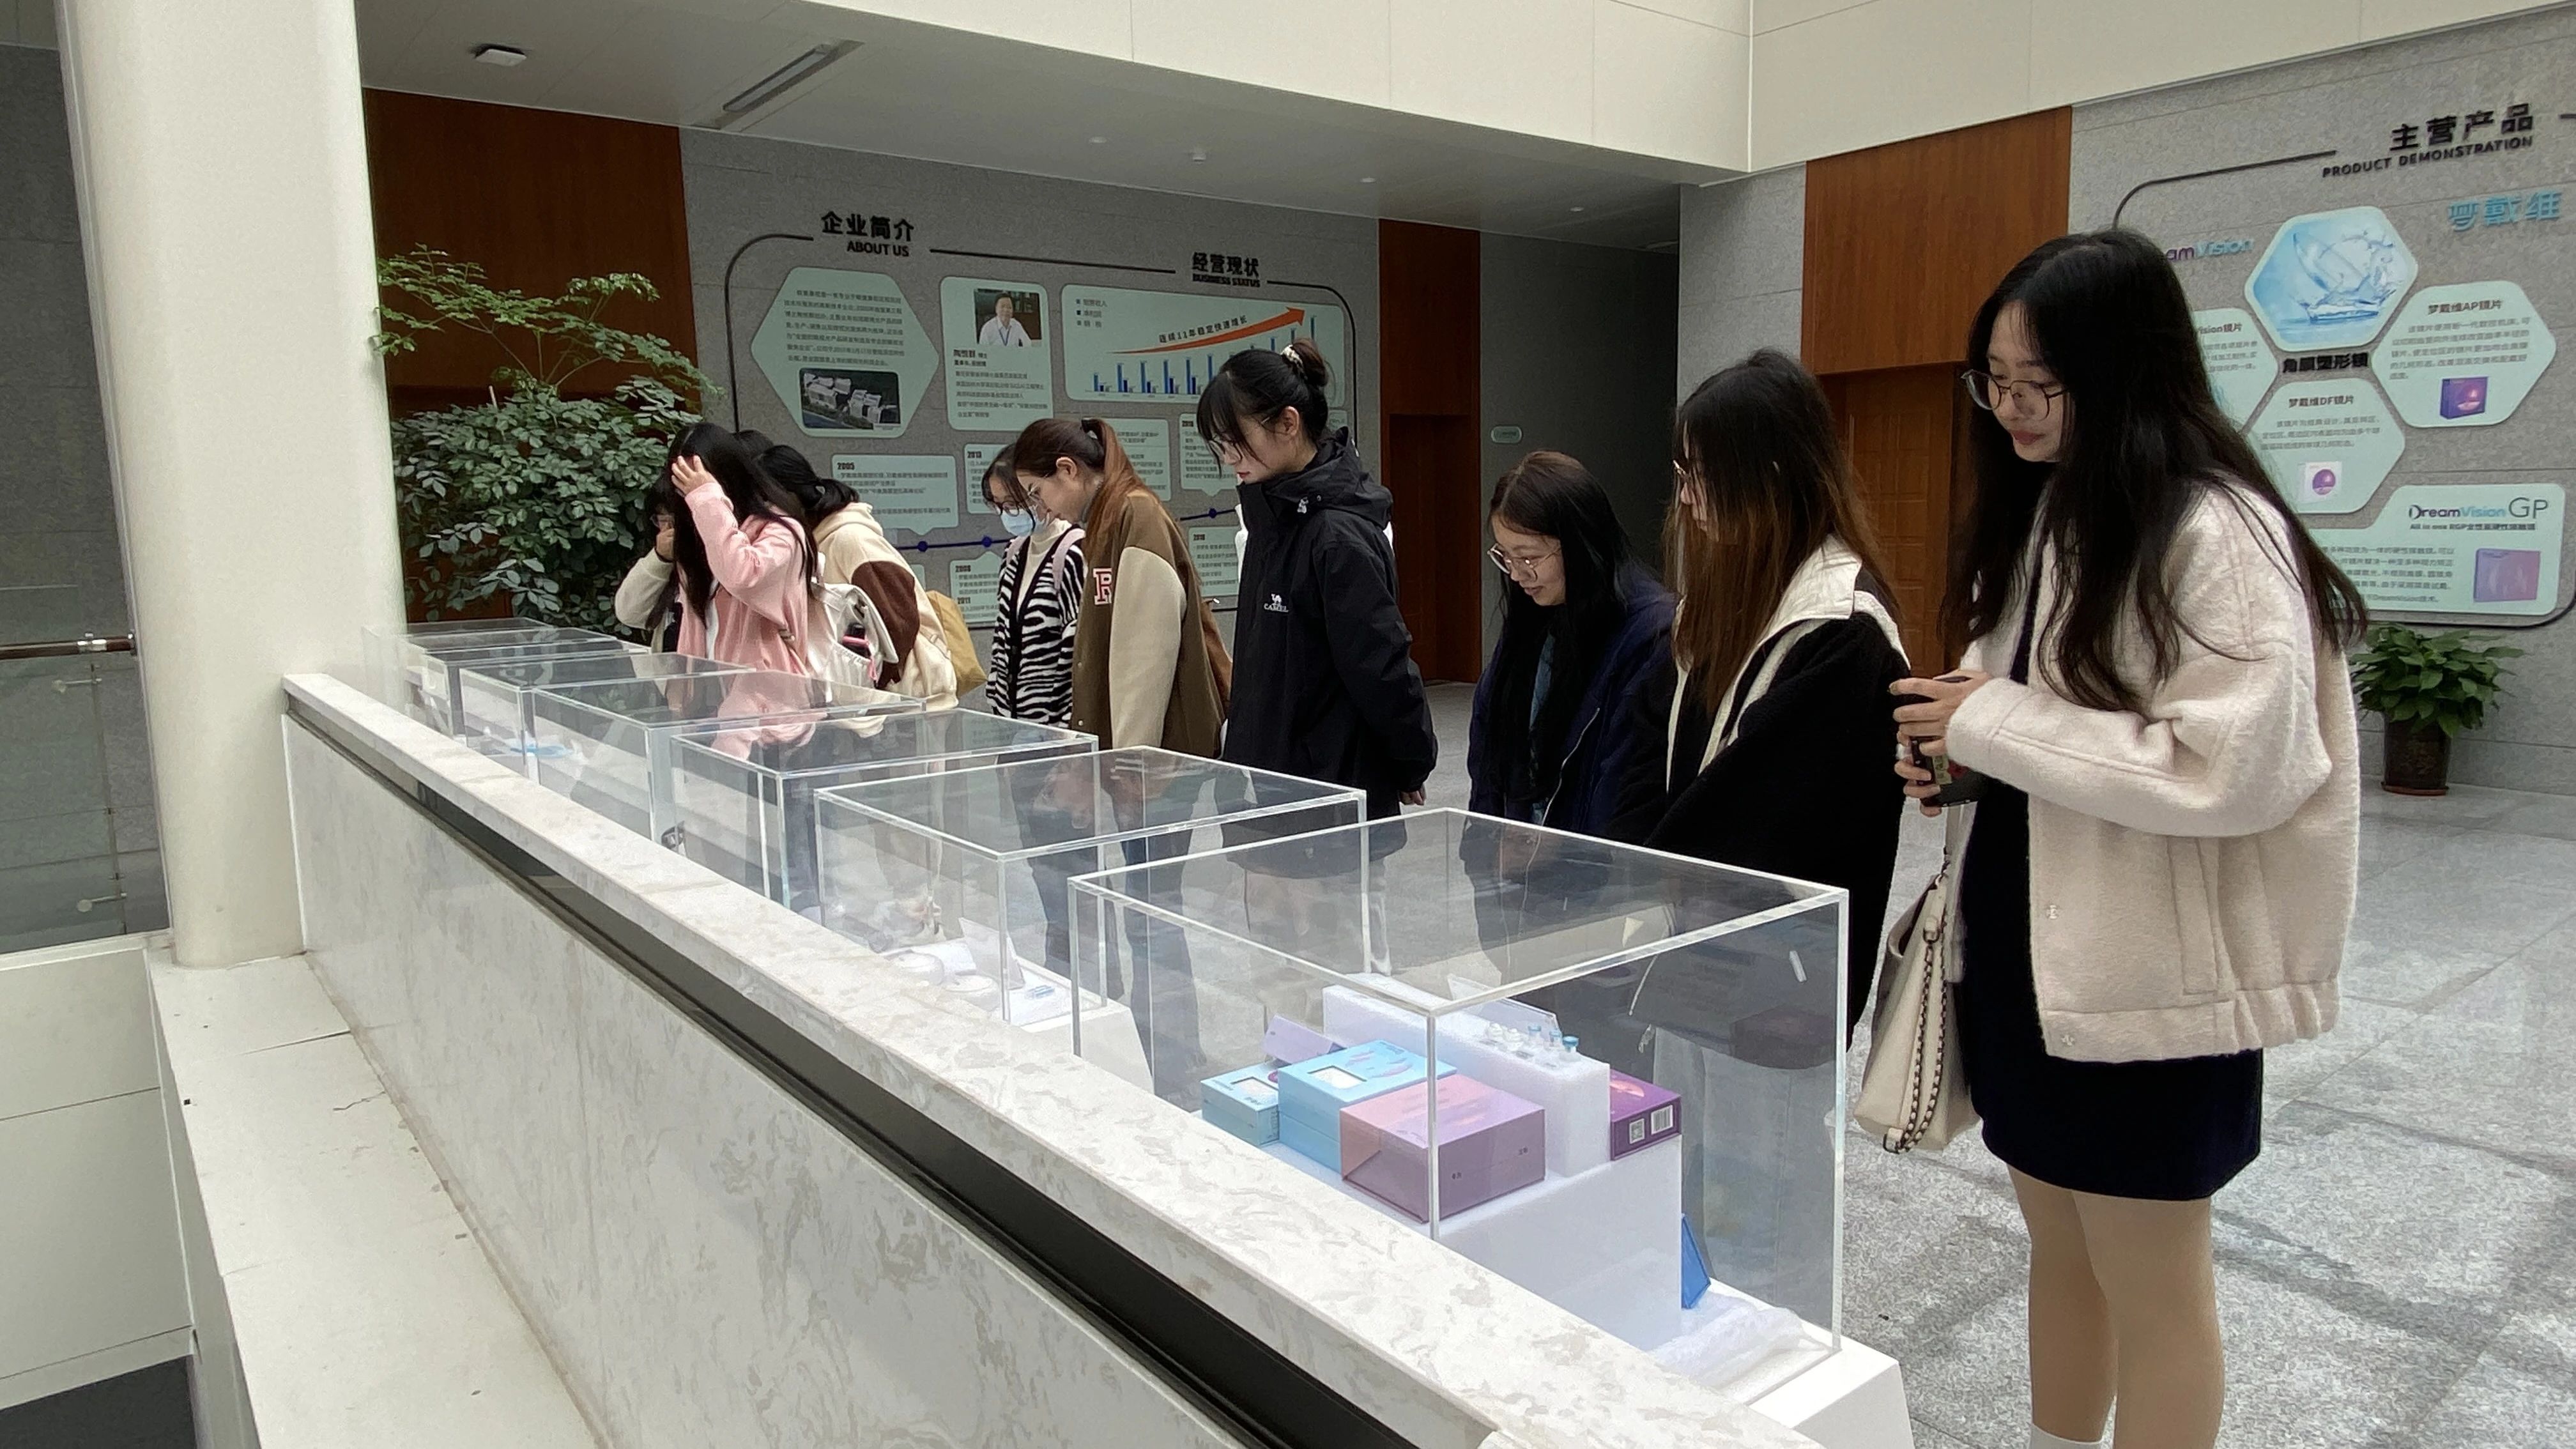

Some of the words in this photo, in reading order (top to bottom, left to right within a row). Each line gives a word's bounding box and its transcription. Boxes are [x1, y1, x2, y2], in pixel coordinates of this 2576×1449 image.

[2389, 103, 2533, 151] 主营产品
[2322, 157, 2392, 178] PRODUCT
[2399, 135, 2533, 166] DEMONSTRATION
[821, 211, 914, 241] 企业简介
[847, 240, 891, 255] ABOUT
[893, 245, 909, 257] US
[2166, 239, 2253, 261] amVision
[1192, 252, 1259, 279] 经营现状
[1192, 273, 1231, 285] BUSINESS
[1232, 277, 1261, 288] STATUS
[2409, 504, 2506, 519] DreamVision
[2508, 496, 2549, 519] GP
